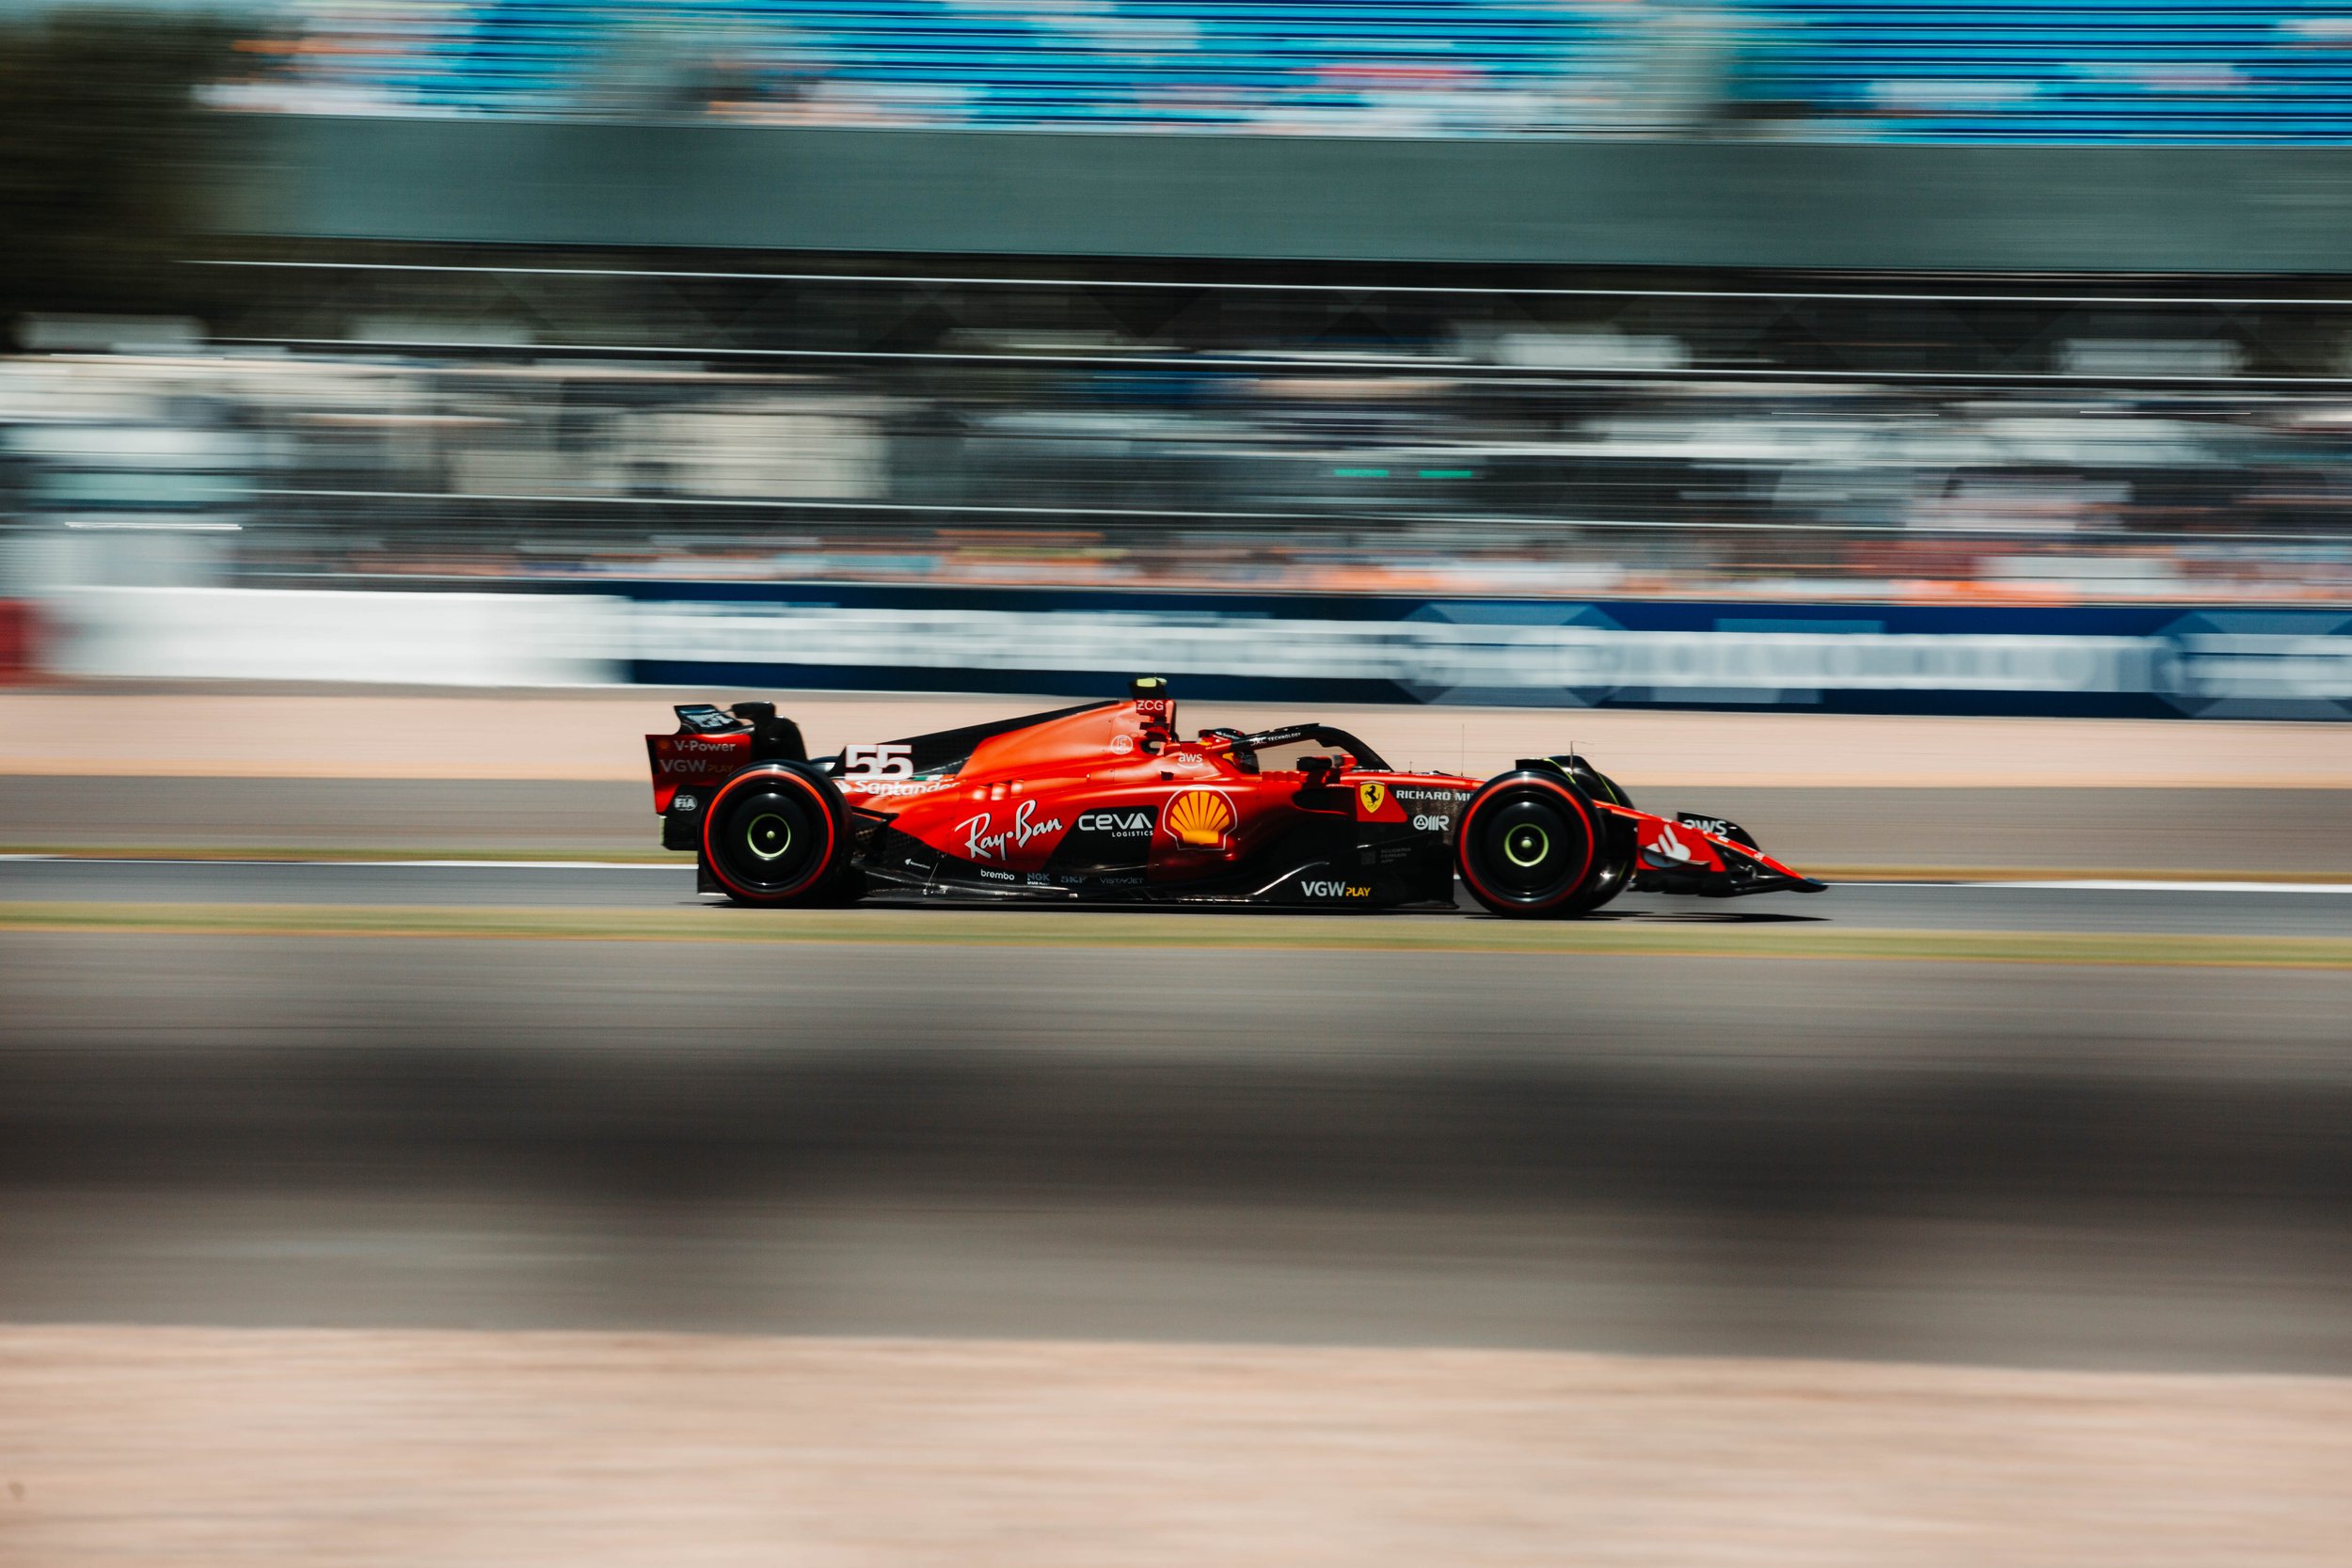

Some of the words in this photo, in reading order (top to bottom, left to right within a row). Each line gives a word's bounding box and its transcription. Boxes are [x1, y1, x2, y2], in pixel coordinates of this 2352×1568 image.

[1267, 732, 1302, 742] TECHNOLOGY
[674, 740, 737, 752] V-Power
[844, 744, 914, 781] 55
[1178, 753, 1203, 764] aws
[660, 759, 707, 773] VGW
[853, 780, 961, 798] Santander
[1396, 790, 1452, 801] RICHARD
[1112, 830, 1154, 838] LOGISTICS
[980, 868, 1016, 881] brembo
[1026, 873, 1051, 882] NGK
[1300, 880, 1346, 897] VGW
[1345, 887, 1372, 897] PLAY
